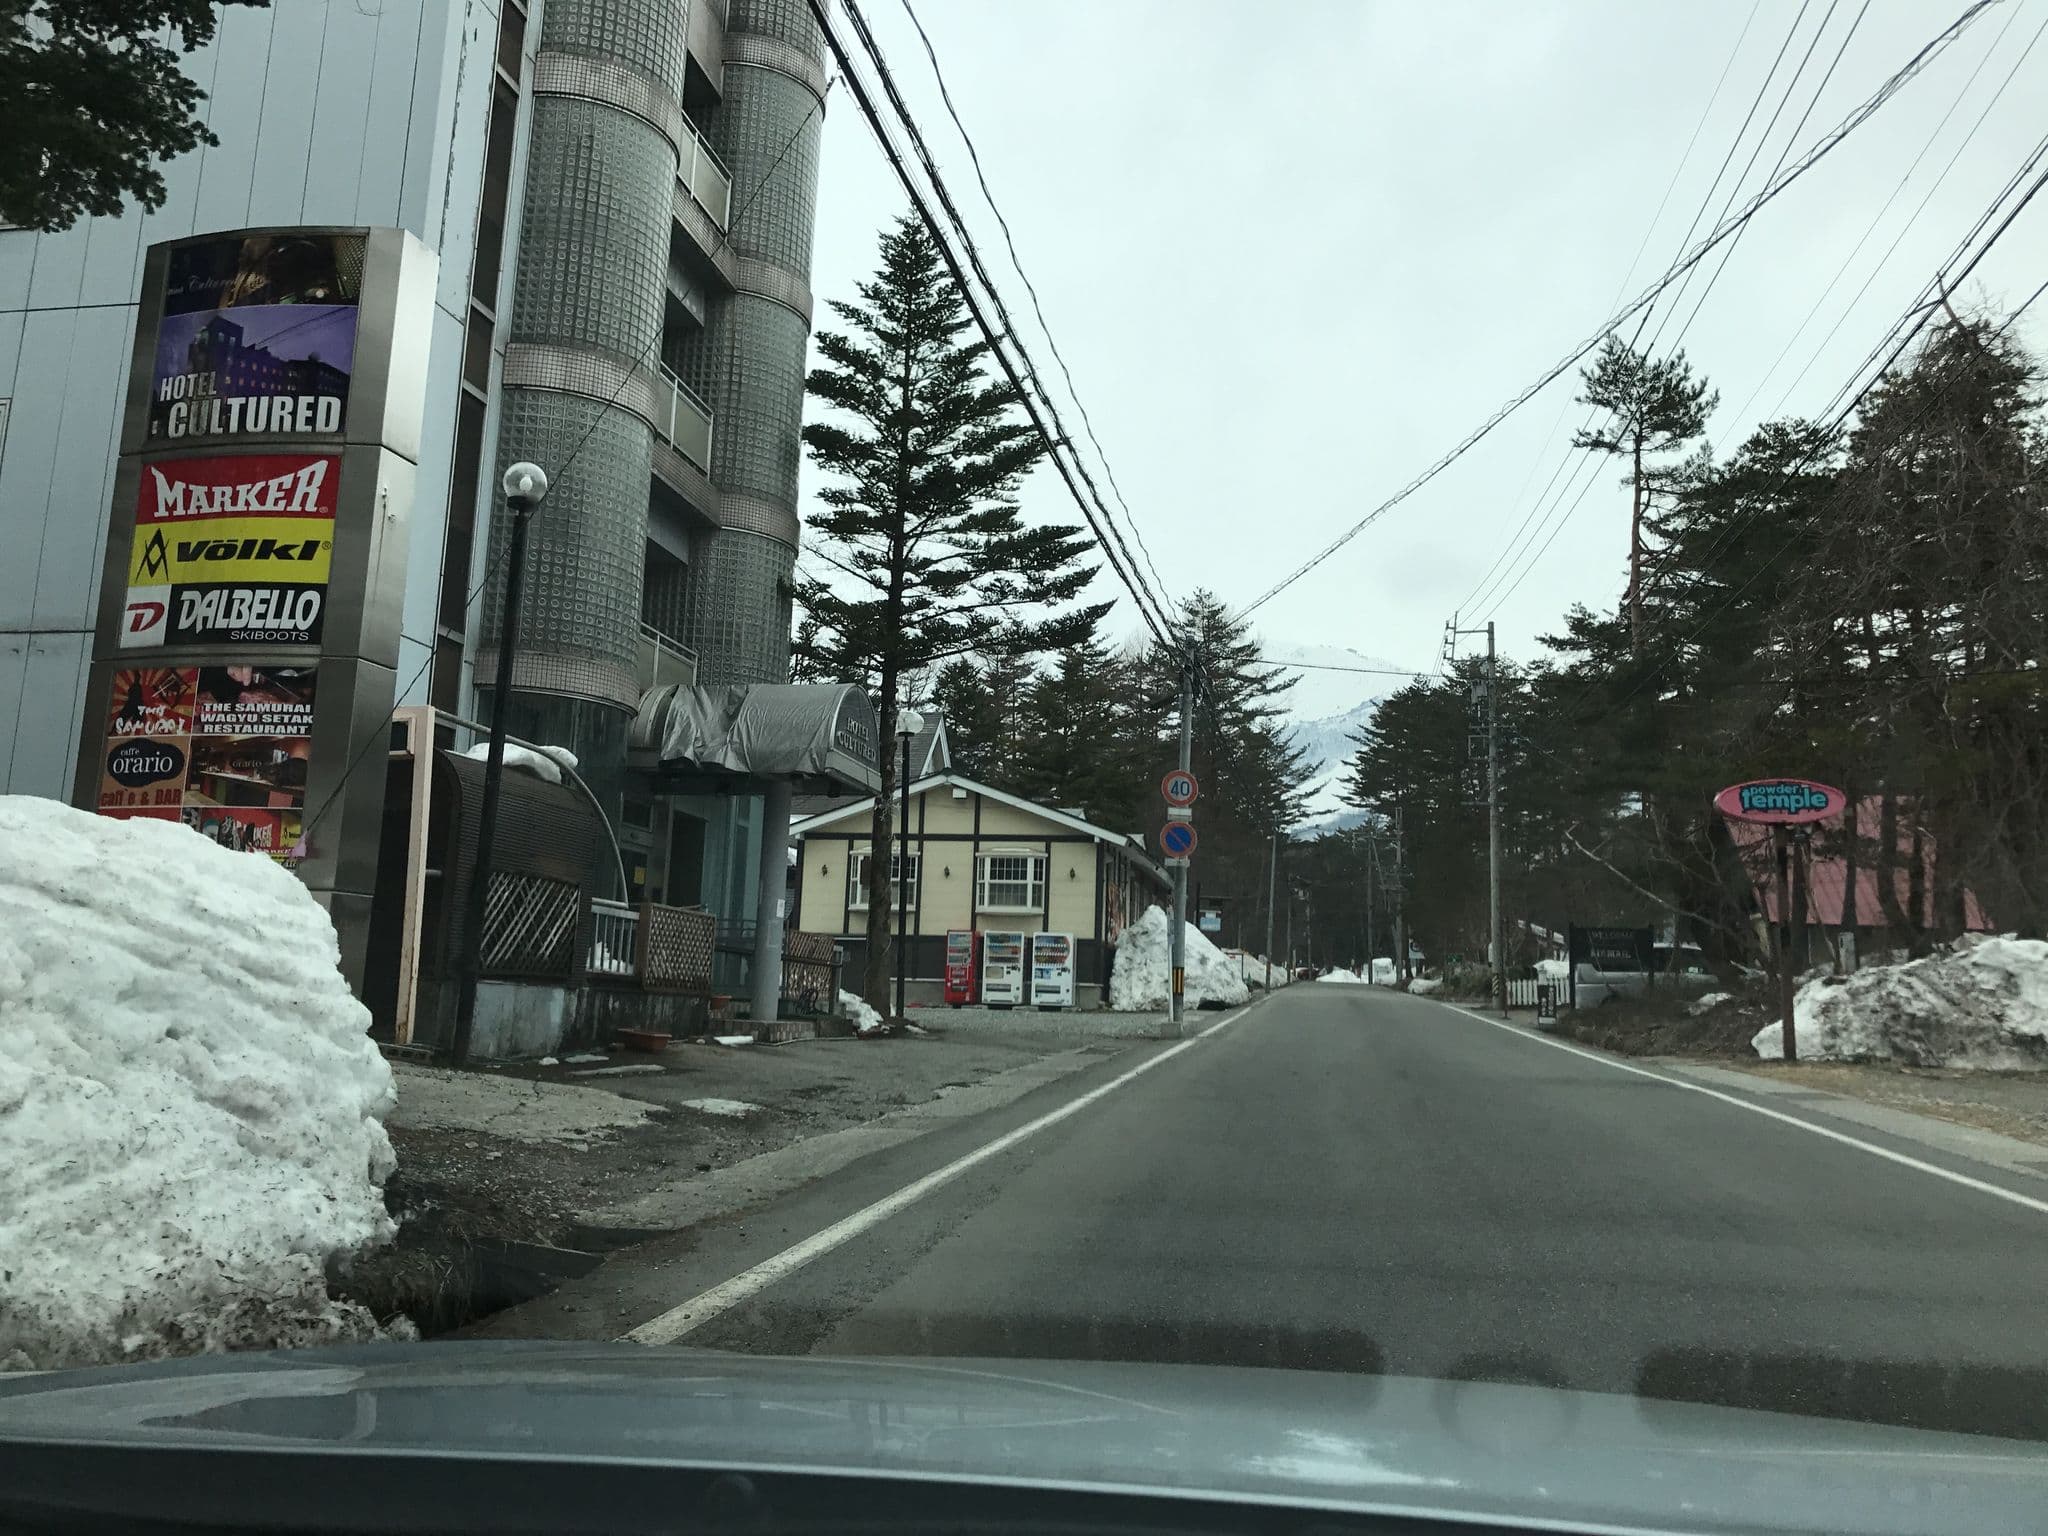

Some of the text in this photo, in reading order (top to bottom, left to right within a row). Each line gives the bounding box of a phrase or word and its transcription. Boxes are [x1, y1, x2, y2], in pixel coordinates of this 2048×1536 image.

[160, 370, 217, 402] HOTEL
[168, 395, 342, 439] CULTURED
[151, 459, 329, 518] MARKER
[177, 589, 321, 635] DALBELLO
[230, 630, 310, 641] SKIBOOTS
[200, 713, 314, 724] WAGYU SETAK
[203, 703, 312, 714] THE SAMURAI
[203, 723, 309, 735] RESTAURANT
[847, 717, 870, 741] HOTEL
[837, 730, 877, 762] CULTURED
[112, 751, 174, 775] orario
[1170, 781, 1190, 797] 40
[1741, 788, 1827, 813] temple
[1750, 784, 1799, 795] powder
